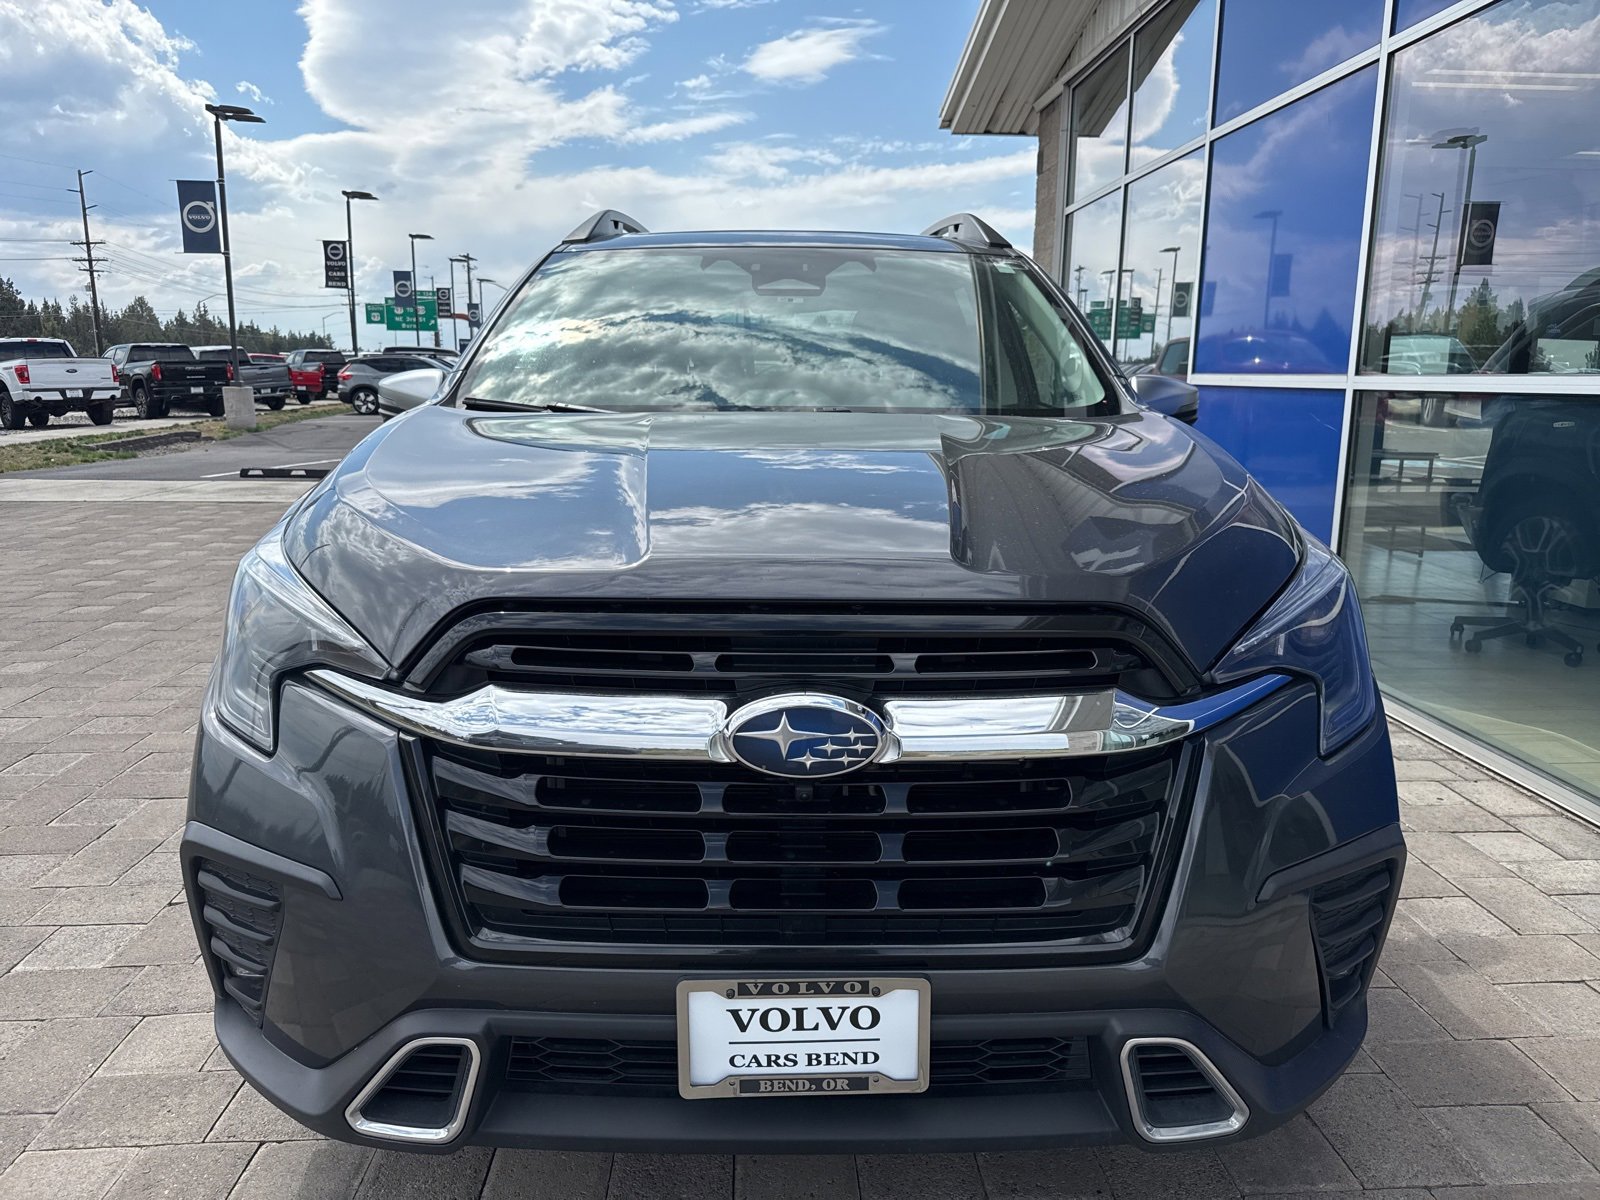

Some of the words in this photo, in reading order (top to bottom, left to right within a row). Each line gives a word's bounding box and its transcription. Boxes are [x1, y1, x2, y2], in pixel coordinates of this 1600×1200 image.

[745, 981, 862, 995] VOLVO
[726, 1005, 881, 1033] VOLVO
[729, 1053, 799, 1068] CARS
[805, 1051, 880, 1067] BEND
[758, 1080, 816, 1093] BEND,
[822, 1078, 850, 1091] OR
